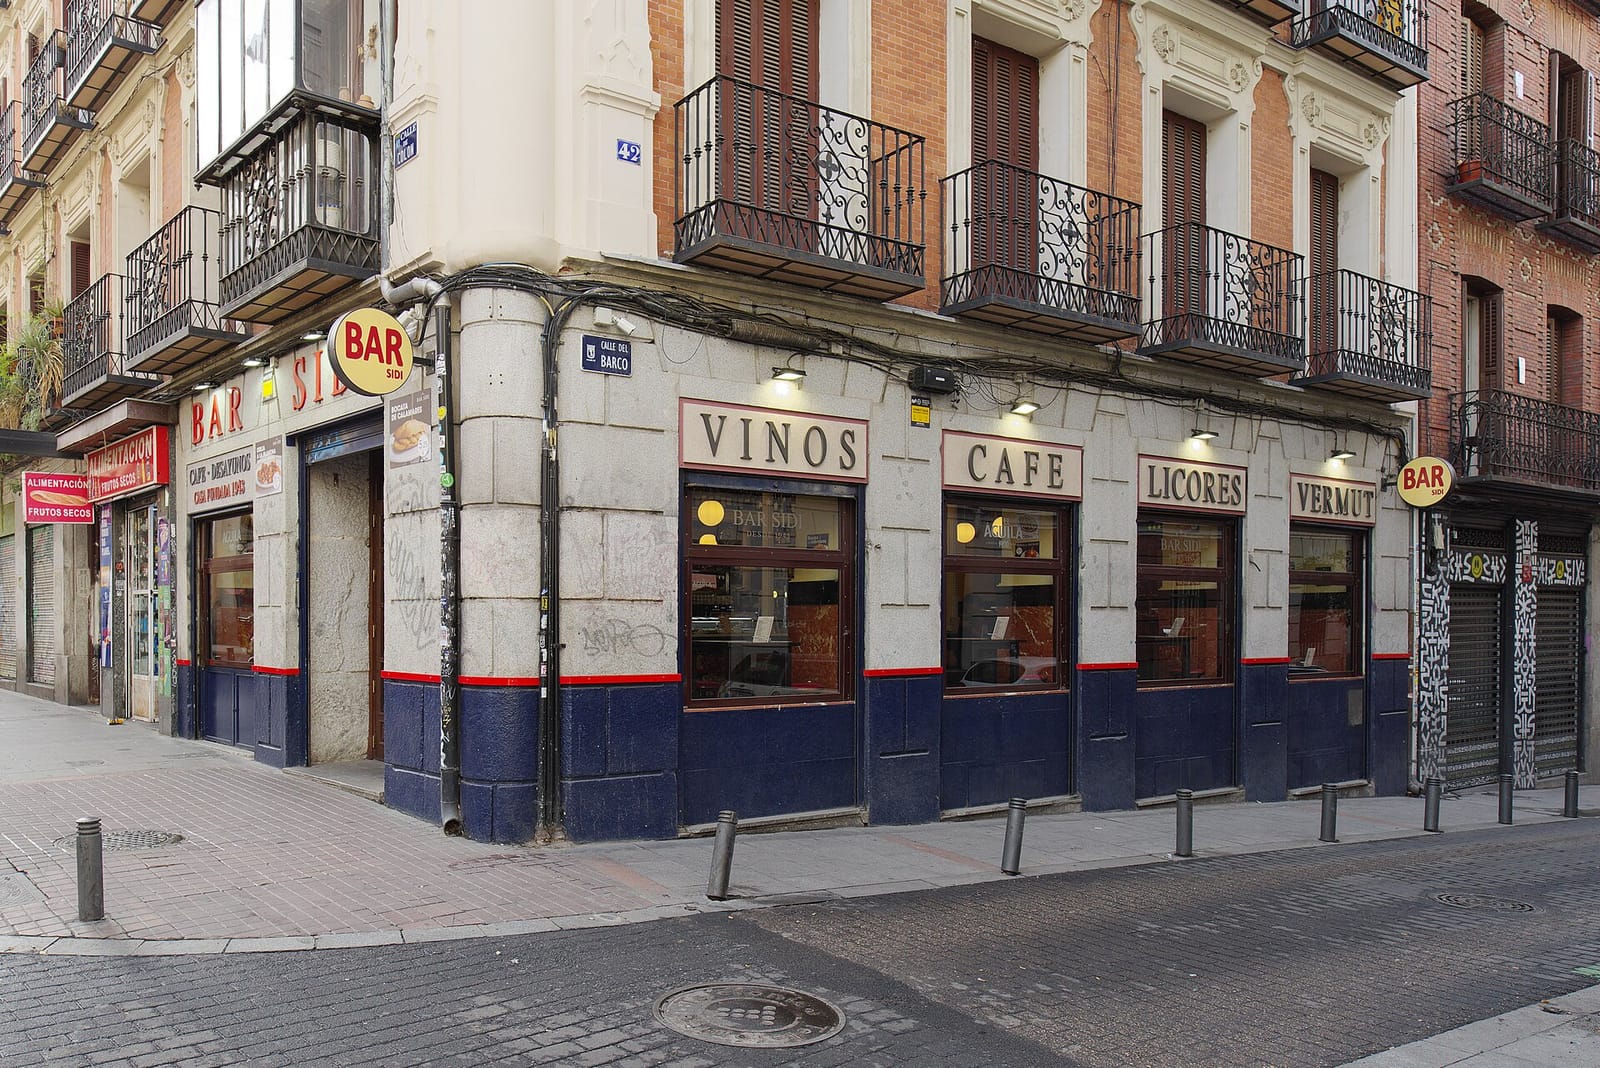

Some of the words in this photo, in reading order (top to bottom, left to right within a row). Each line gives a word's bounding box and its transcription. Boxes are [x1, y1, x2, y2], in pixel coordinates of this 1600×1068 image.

[618, 142, 640, 162] 42
[345, 321, 403, 367] BAR
[600, 340, 616, 351] CALLE
[618, 343, 629, 353] DEL
[385, 368, 404, 380] SIDI
[600, 355, 629, 371] BARCO
[192, 387, 243, 445] BAR
[699, 412, 857, 471] VINOS
[211, 453, 251, 480] DESAYUNOS
[967, 443, 1064, 489] CAFE
[27, 478, 89, 490] ALIMENTACIÓN
[101, 477, 119, 494] FRUTOS
[120, 472, 136, 488] SECOS
[1147, 464, 1243, 506] LICORES
[1403, 465, 1444, 490] BAR
[1297, 481, 1375, 518] VERMUT
[1431, 488, 1444, 496] SIDI
[28, 507, 62, 517] FRUTOS
[63, 508, 91, 518] SECOS
[733, 509, 768, 527] BAR
[771, 511, 802, 529] SIDI
